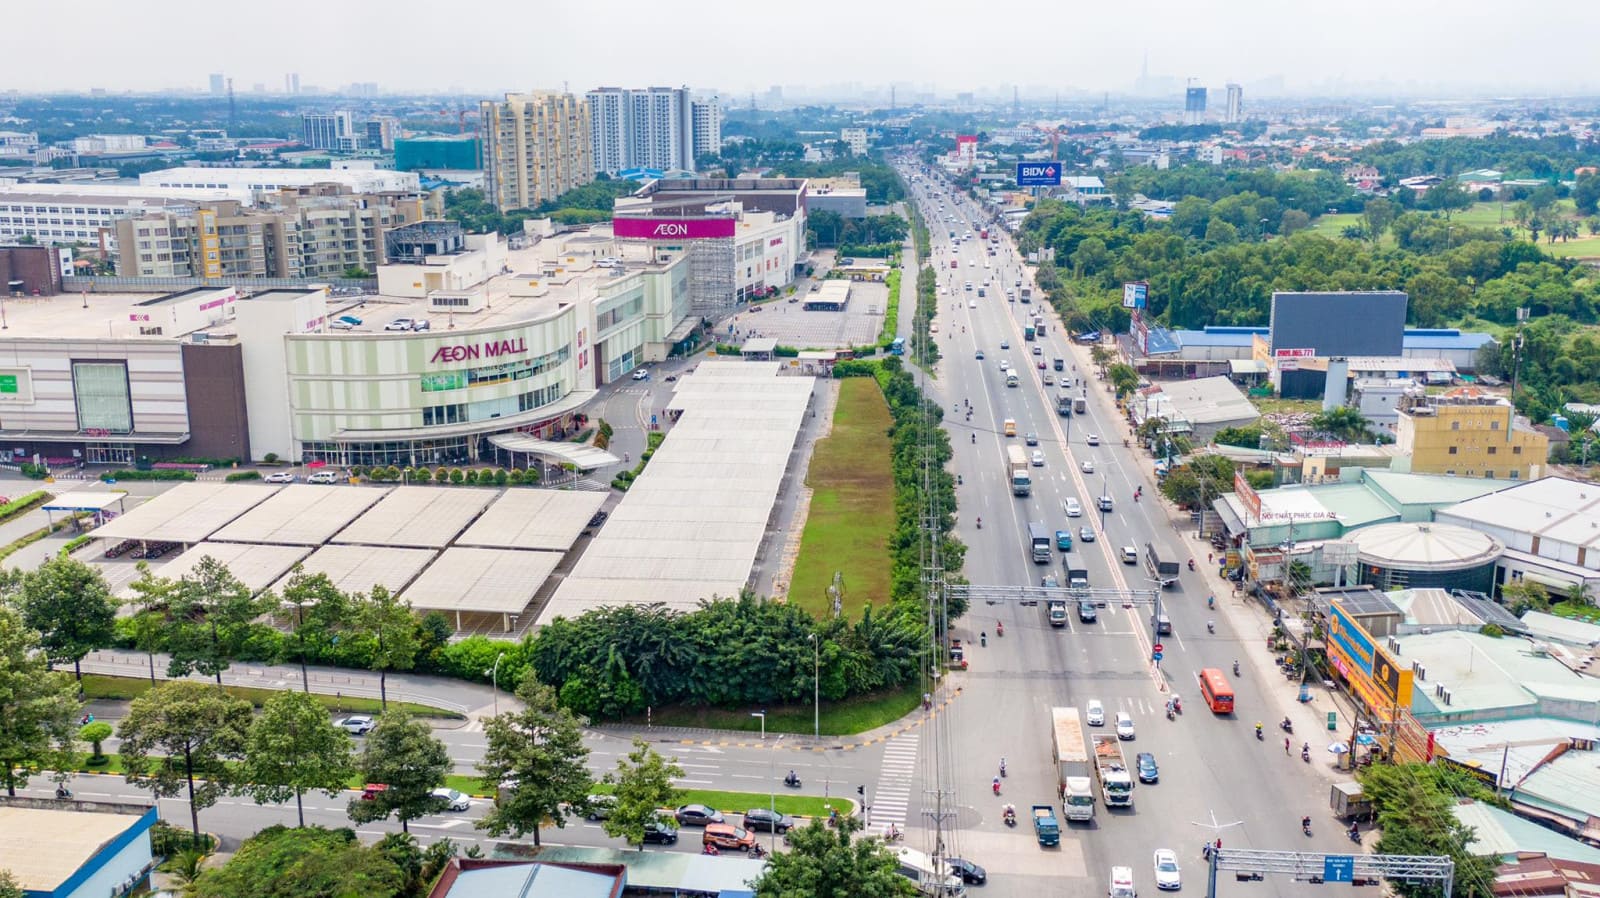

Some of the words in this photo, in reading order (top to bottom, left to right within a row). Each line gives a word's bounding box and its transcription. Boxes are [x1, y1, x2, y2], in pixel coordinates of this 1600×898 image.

[1022, 167, 1045, 177] BIDV
[653, 223, 688, 235] ÆON
[430, 343, 480, 363] ÆON
[484, 337, 528, 358] MALL
